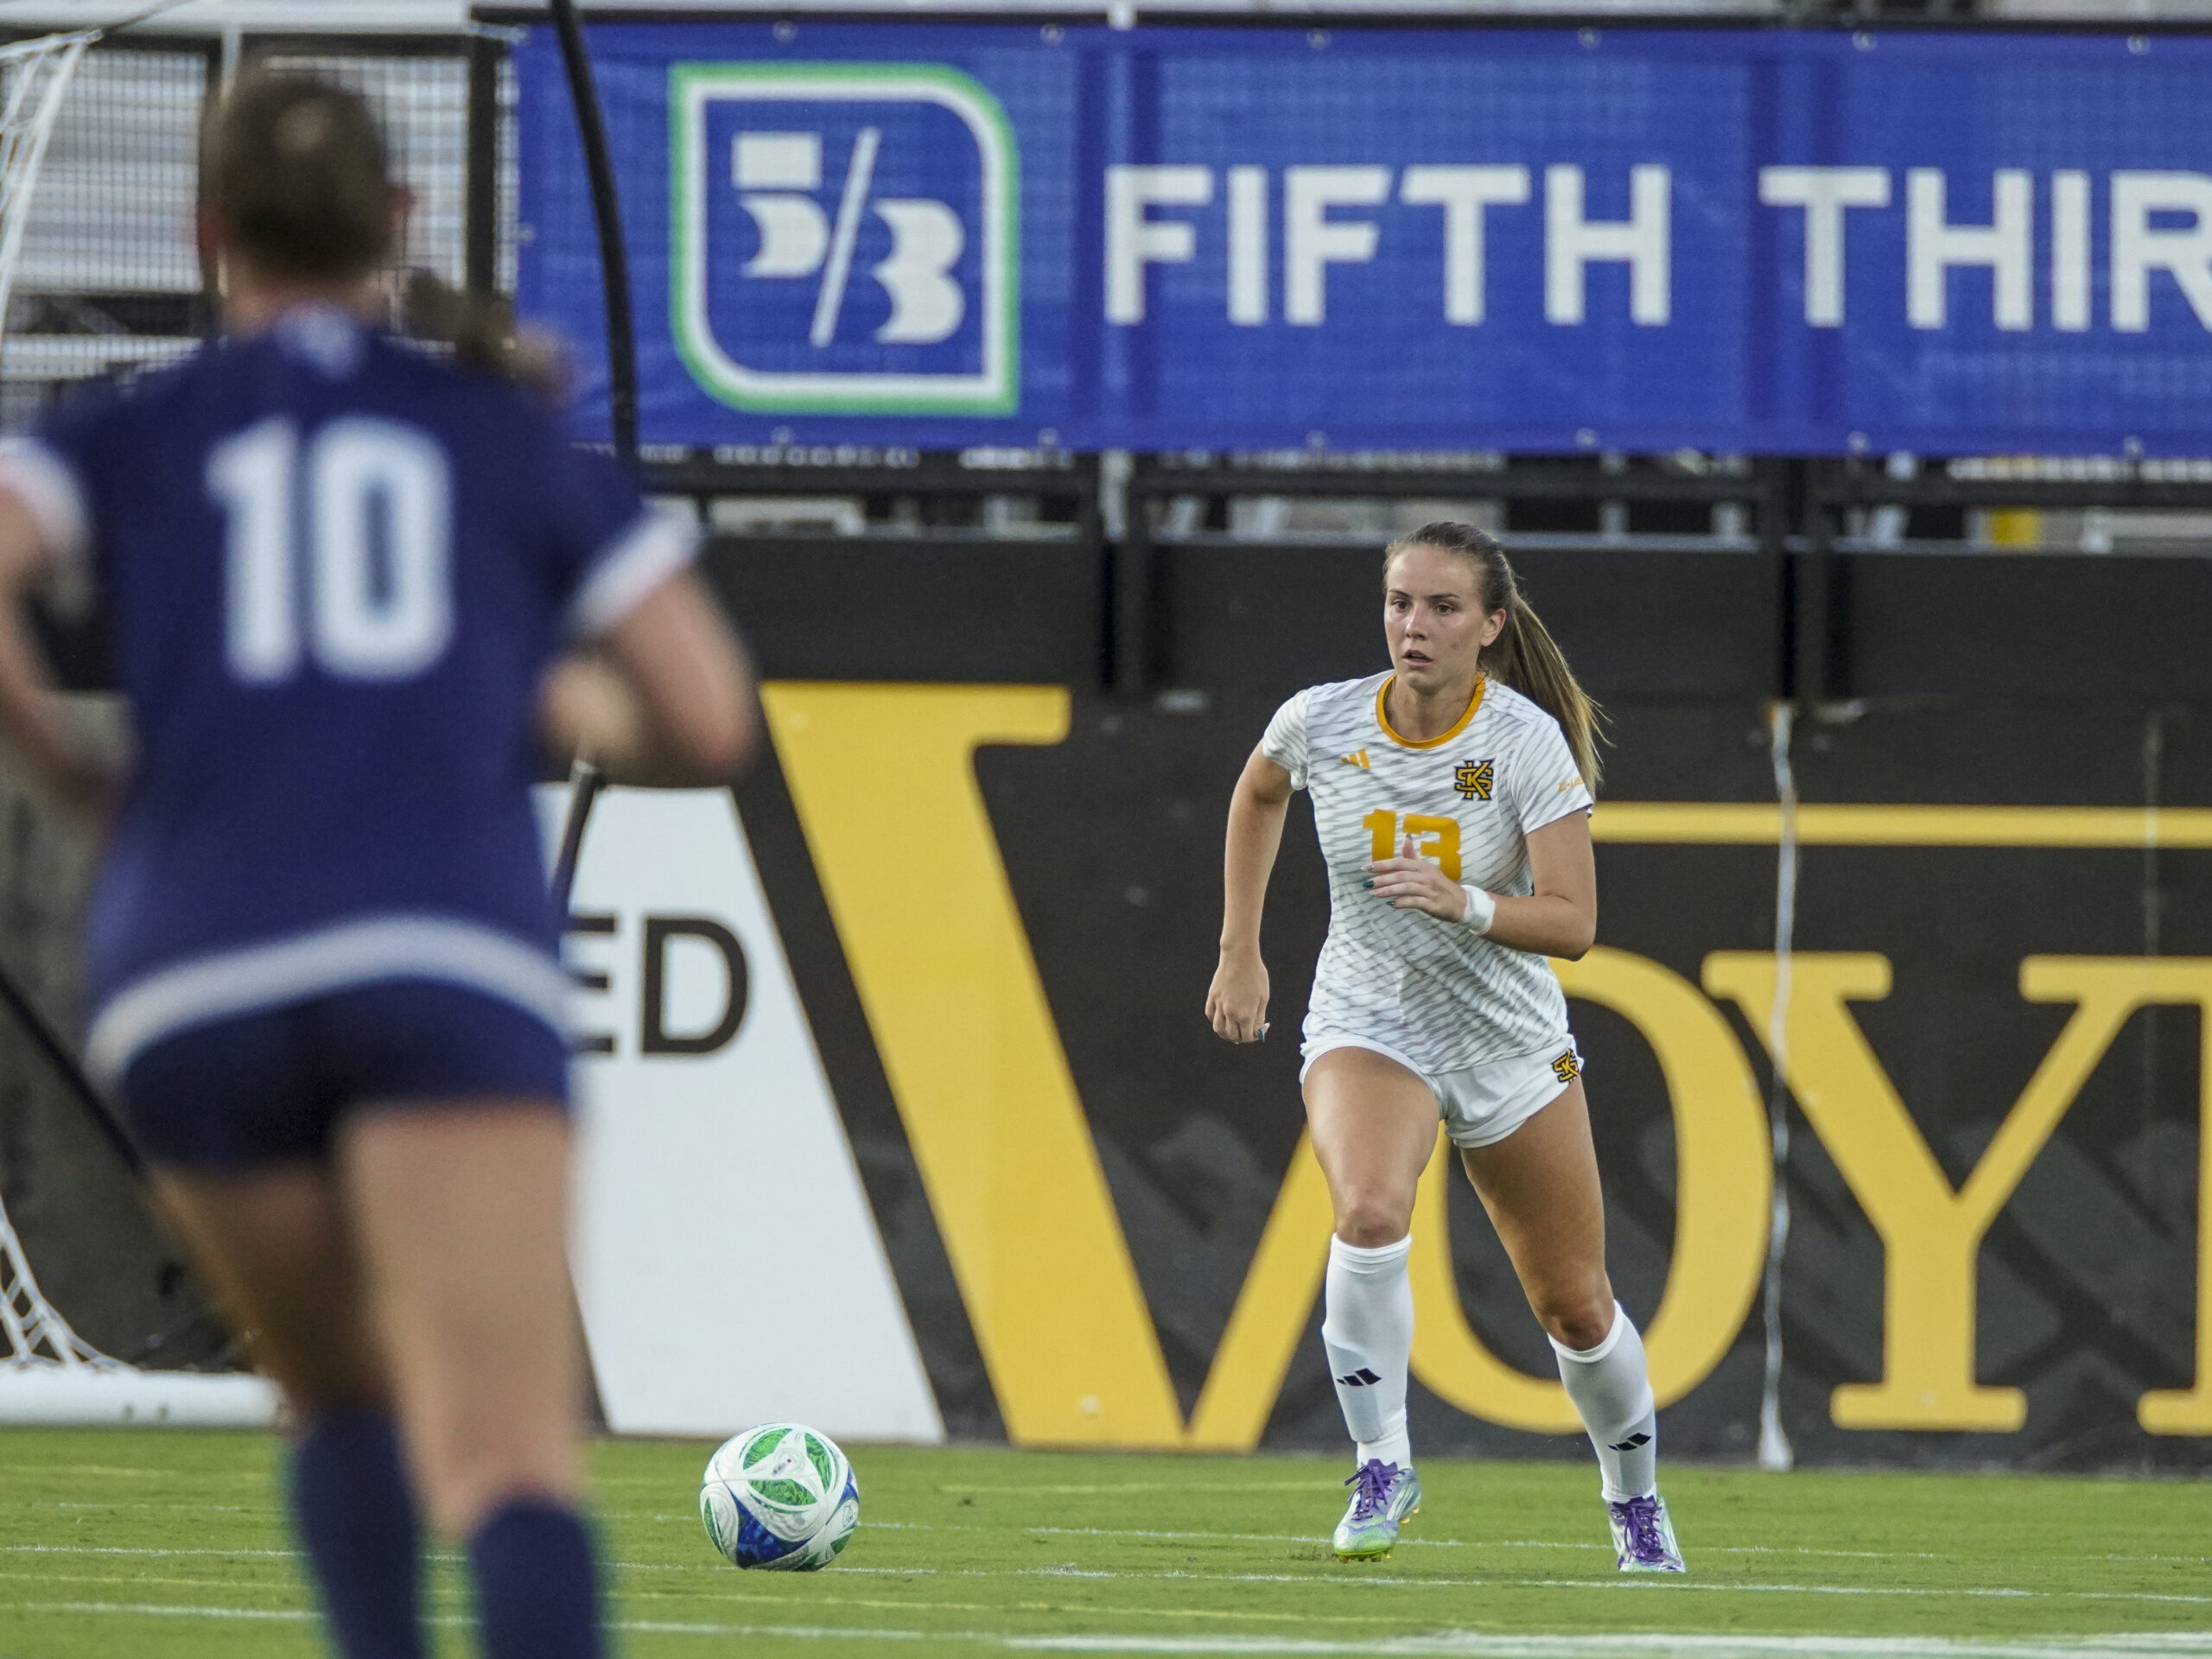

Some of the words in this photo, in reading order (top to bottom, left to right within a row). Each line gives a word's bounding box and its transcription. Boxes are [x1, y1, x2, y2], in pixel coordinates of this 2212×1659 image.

[1103, 163, 1672, 327] FIFTH
[1758, 165, 2212, 333] THIR
[207, 415, 455, 684] 10
[1363, 809, 1462, 881] 13
